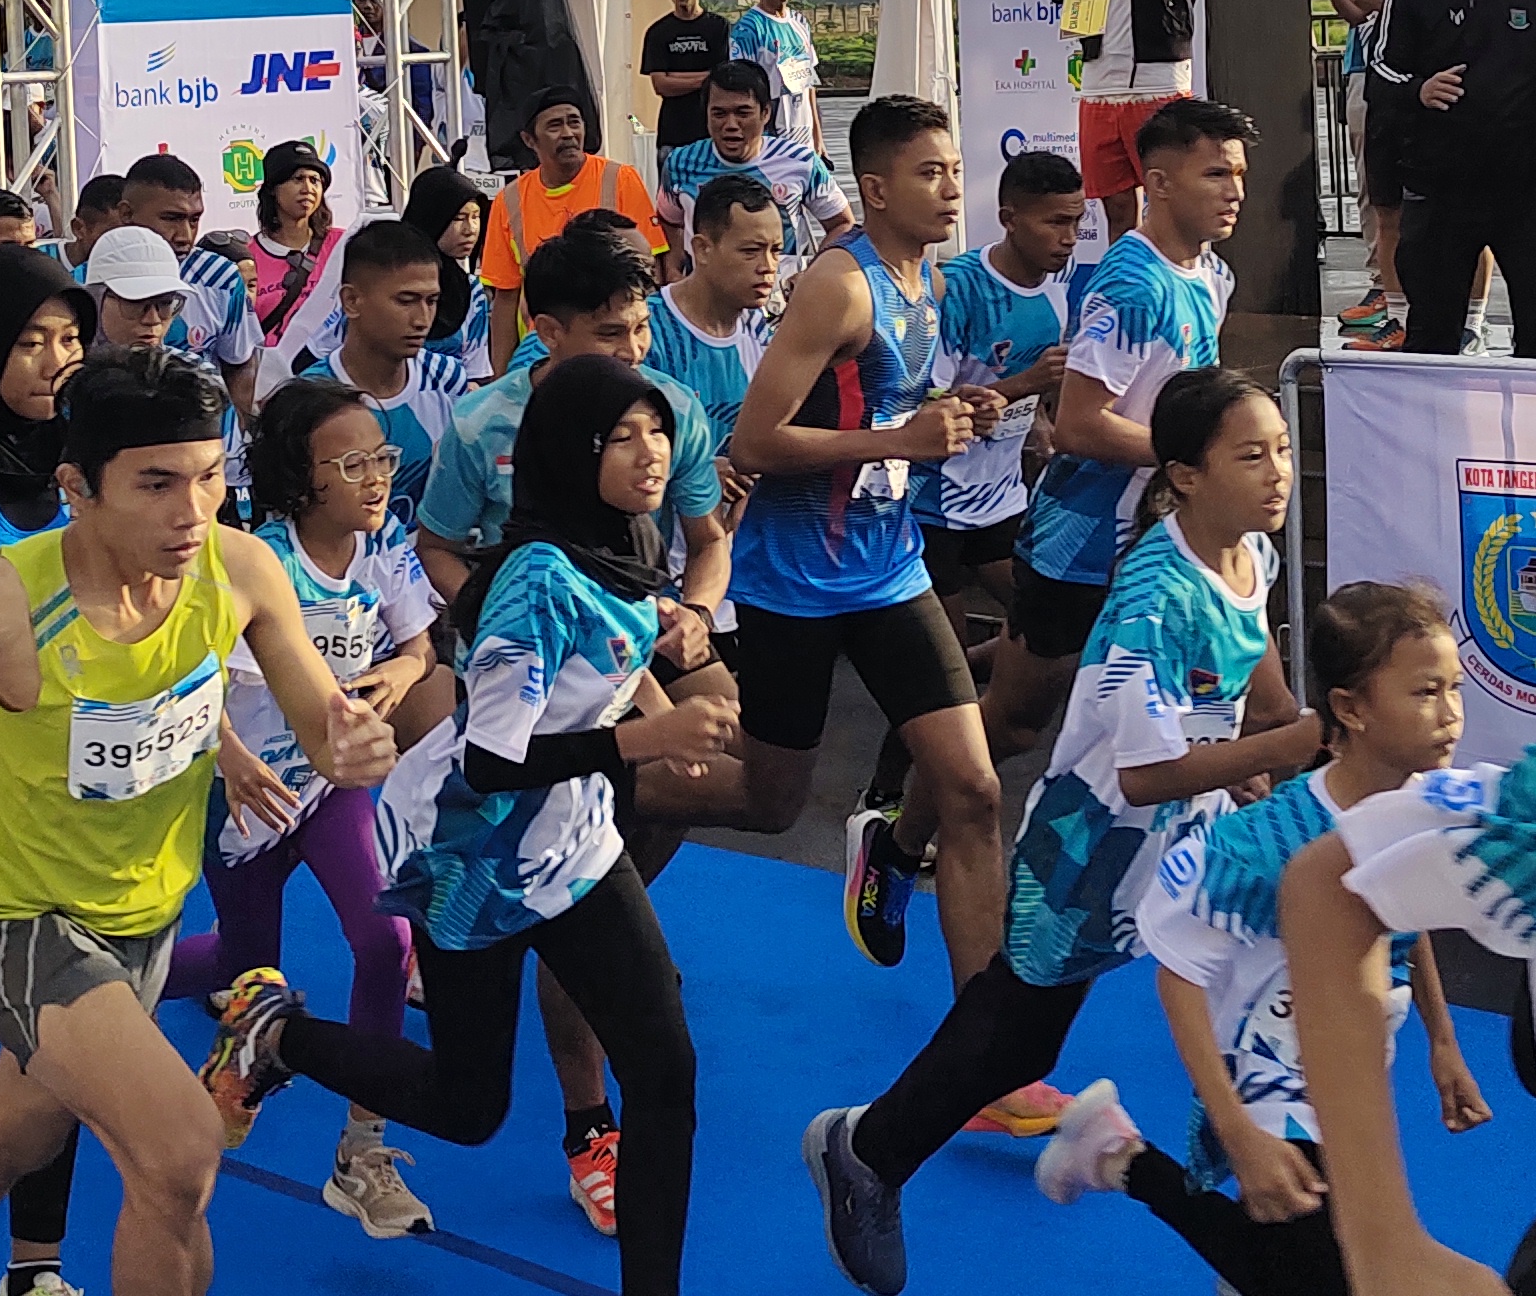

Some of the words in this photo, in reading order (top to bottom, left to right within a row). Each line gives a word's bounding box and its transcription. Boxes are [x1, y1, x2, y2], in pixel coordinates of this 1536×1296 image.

[992, 2, 1033, 23] bank
[240, 50, 342, 95] JNE
[995, 80, 1012, 90] EKA
[1014, 79, 1057, 90] HOSPITAL
[115, 79, 172, 108] bank
[177, 76, 219, 109] bjb
[1032, 131, 1078, 143] multimedi
[1464, 467, 1495, 488] KOTA
[1467, 654, 1513, 696] CERDAS
[84, 703, 211, 769] 395523
